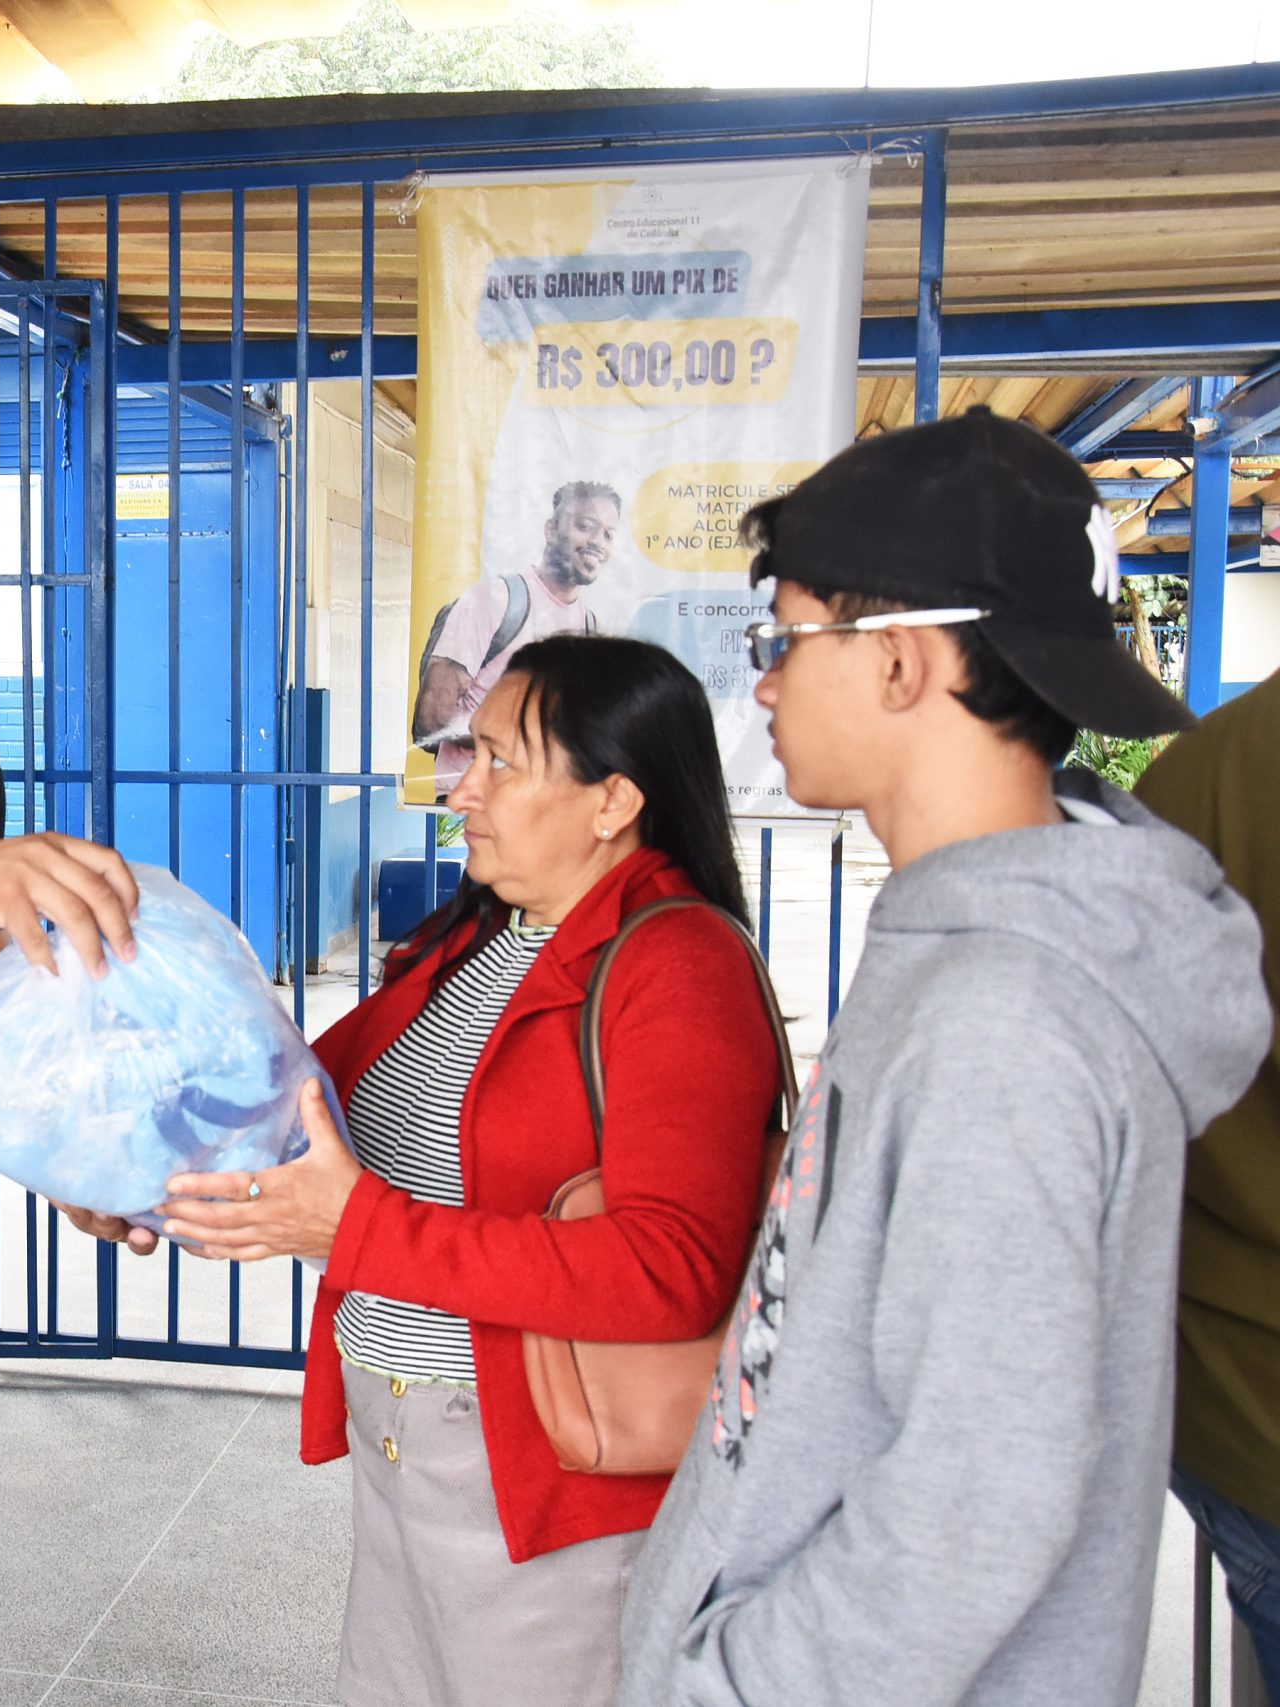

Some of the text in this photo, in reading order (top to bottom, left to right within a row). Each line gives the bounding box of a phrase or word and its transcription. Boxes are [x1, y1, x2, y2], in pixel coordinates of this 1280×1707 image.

[606, 218, 635, 229] Centro
[486, 267, 738, 301] QUER GANHAR UM PIX DE
[536, 338, 775, 392] R$ 300,00 ?
[128, 479, 153, 490] SALA
[664, 536, 703, 549] ANO
[678, 602, 688, 616] E
[738, 785, 783, 798] regras
